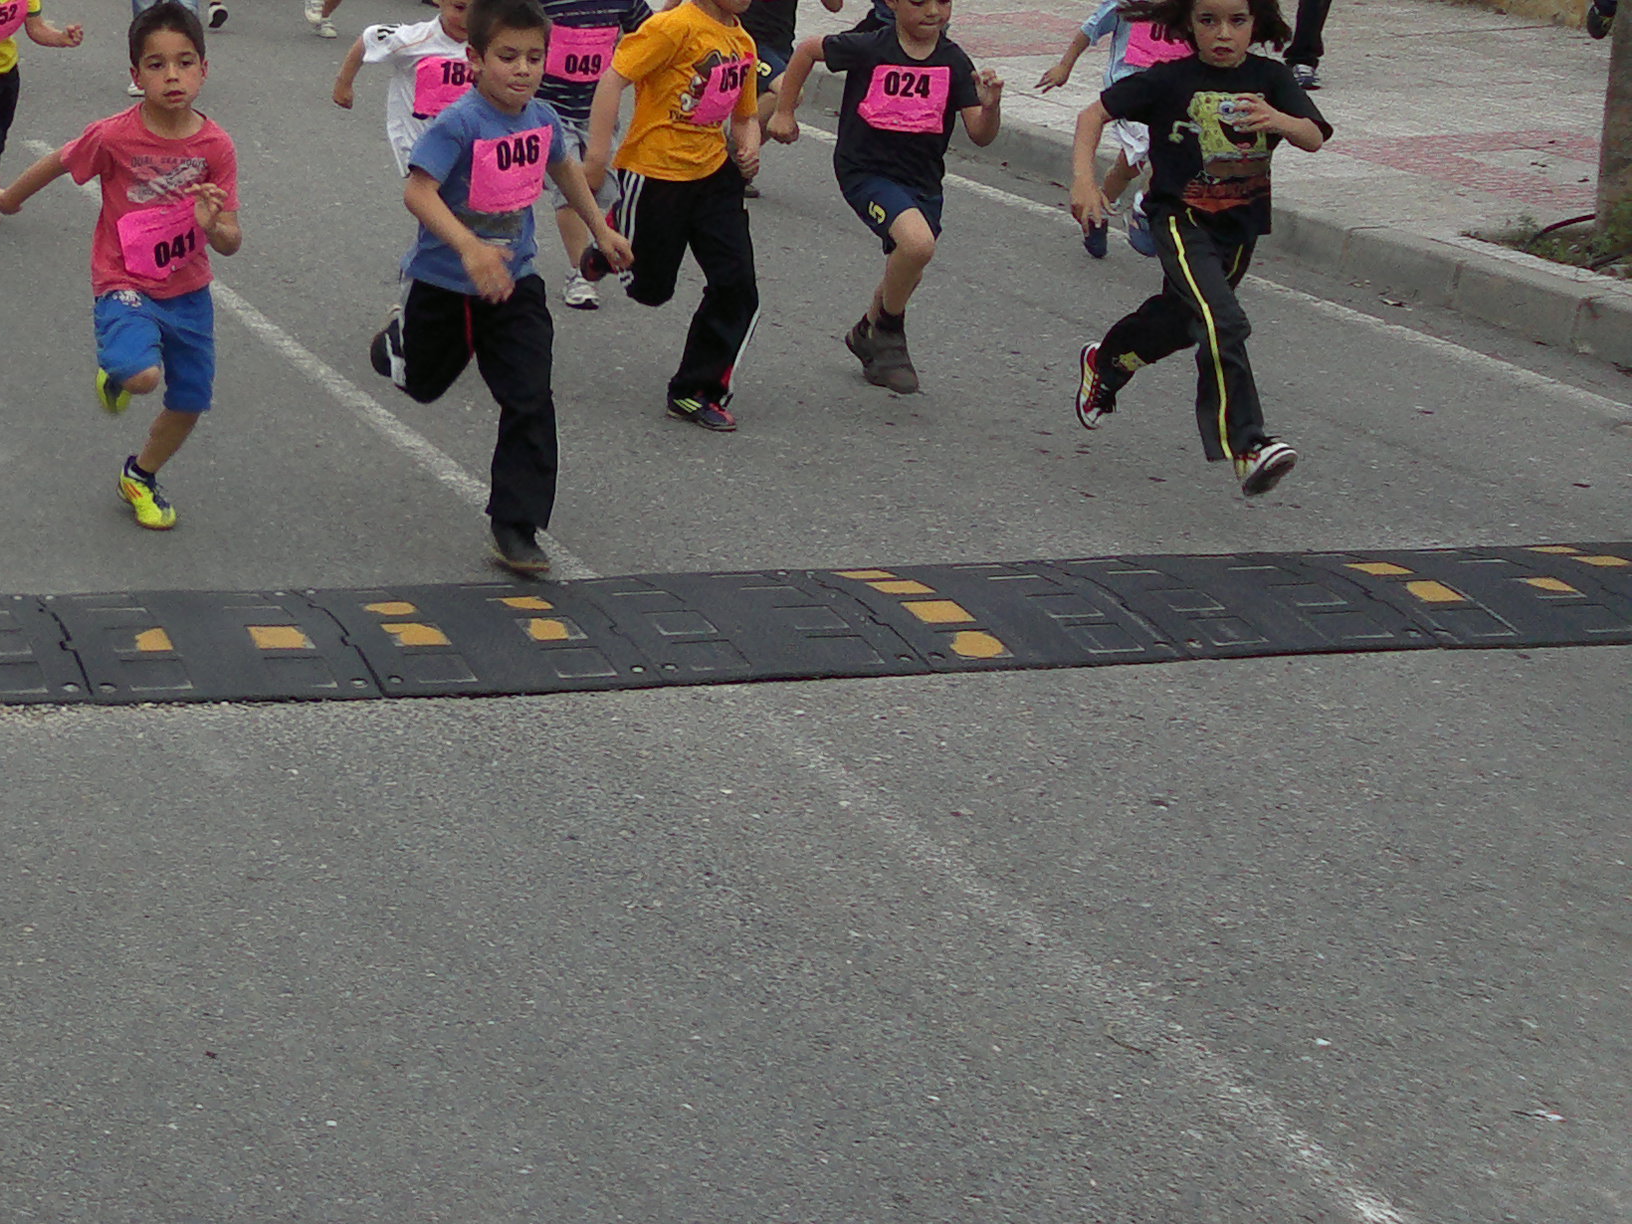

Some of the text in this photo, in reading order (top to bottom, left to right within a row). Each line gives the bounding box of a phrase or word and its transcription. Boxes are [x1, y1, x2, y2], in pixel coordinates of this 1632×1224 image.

[565, 54, 602, 75] 049
[884, 71, 930, 98] 024
[496, 134, 540, 171] 046
[154, 226, 196, 269] 041
